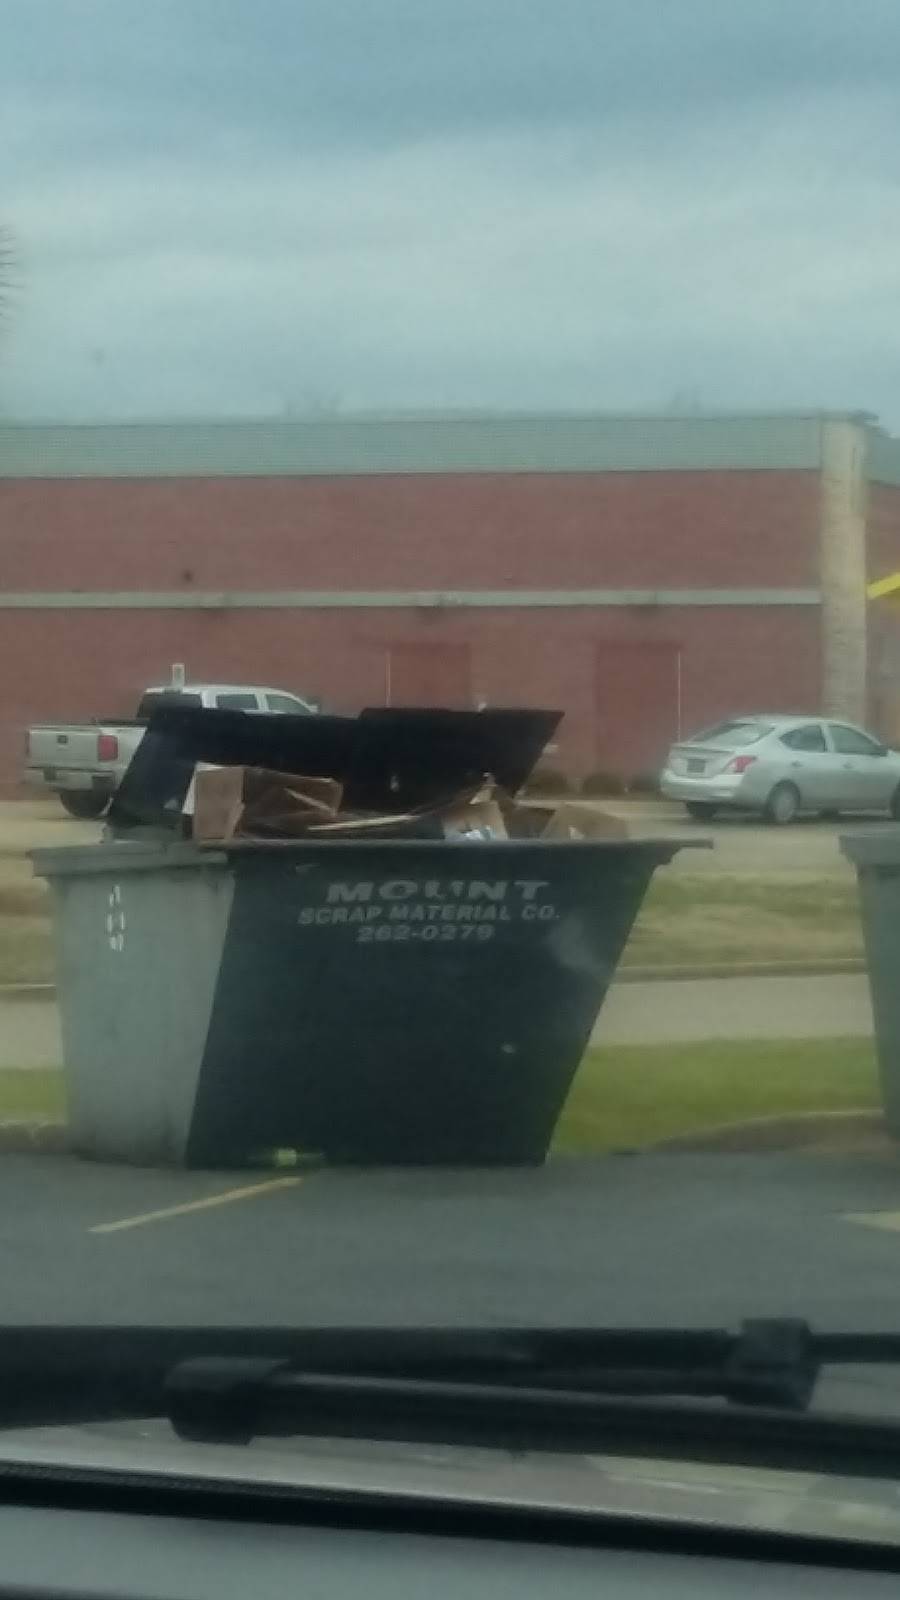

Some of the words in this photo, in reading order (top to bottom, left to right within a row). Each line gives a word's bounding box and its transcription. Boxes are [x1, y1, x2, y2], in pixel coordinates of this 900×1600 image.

[326, 880, 551, 902] MOUNT
[298, 905, 382, 925] SCRAP
[389, 904, 511, 921] MATERIAL
[521, 904, 560, 920] CO.
